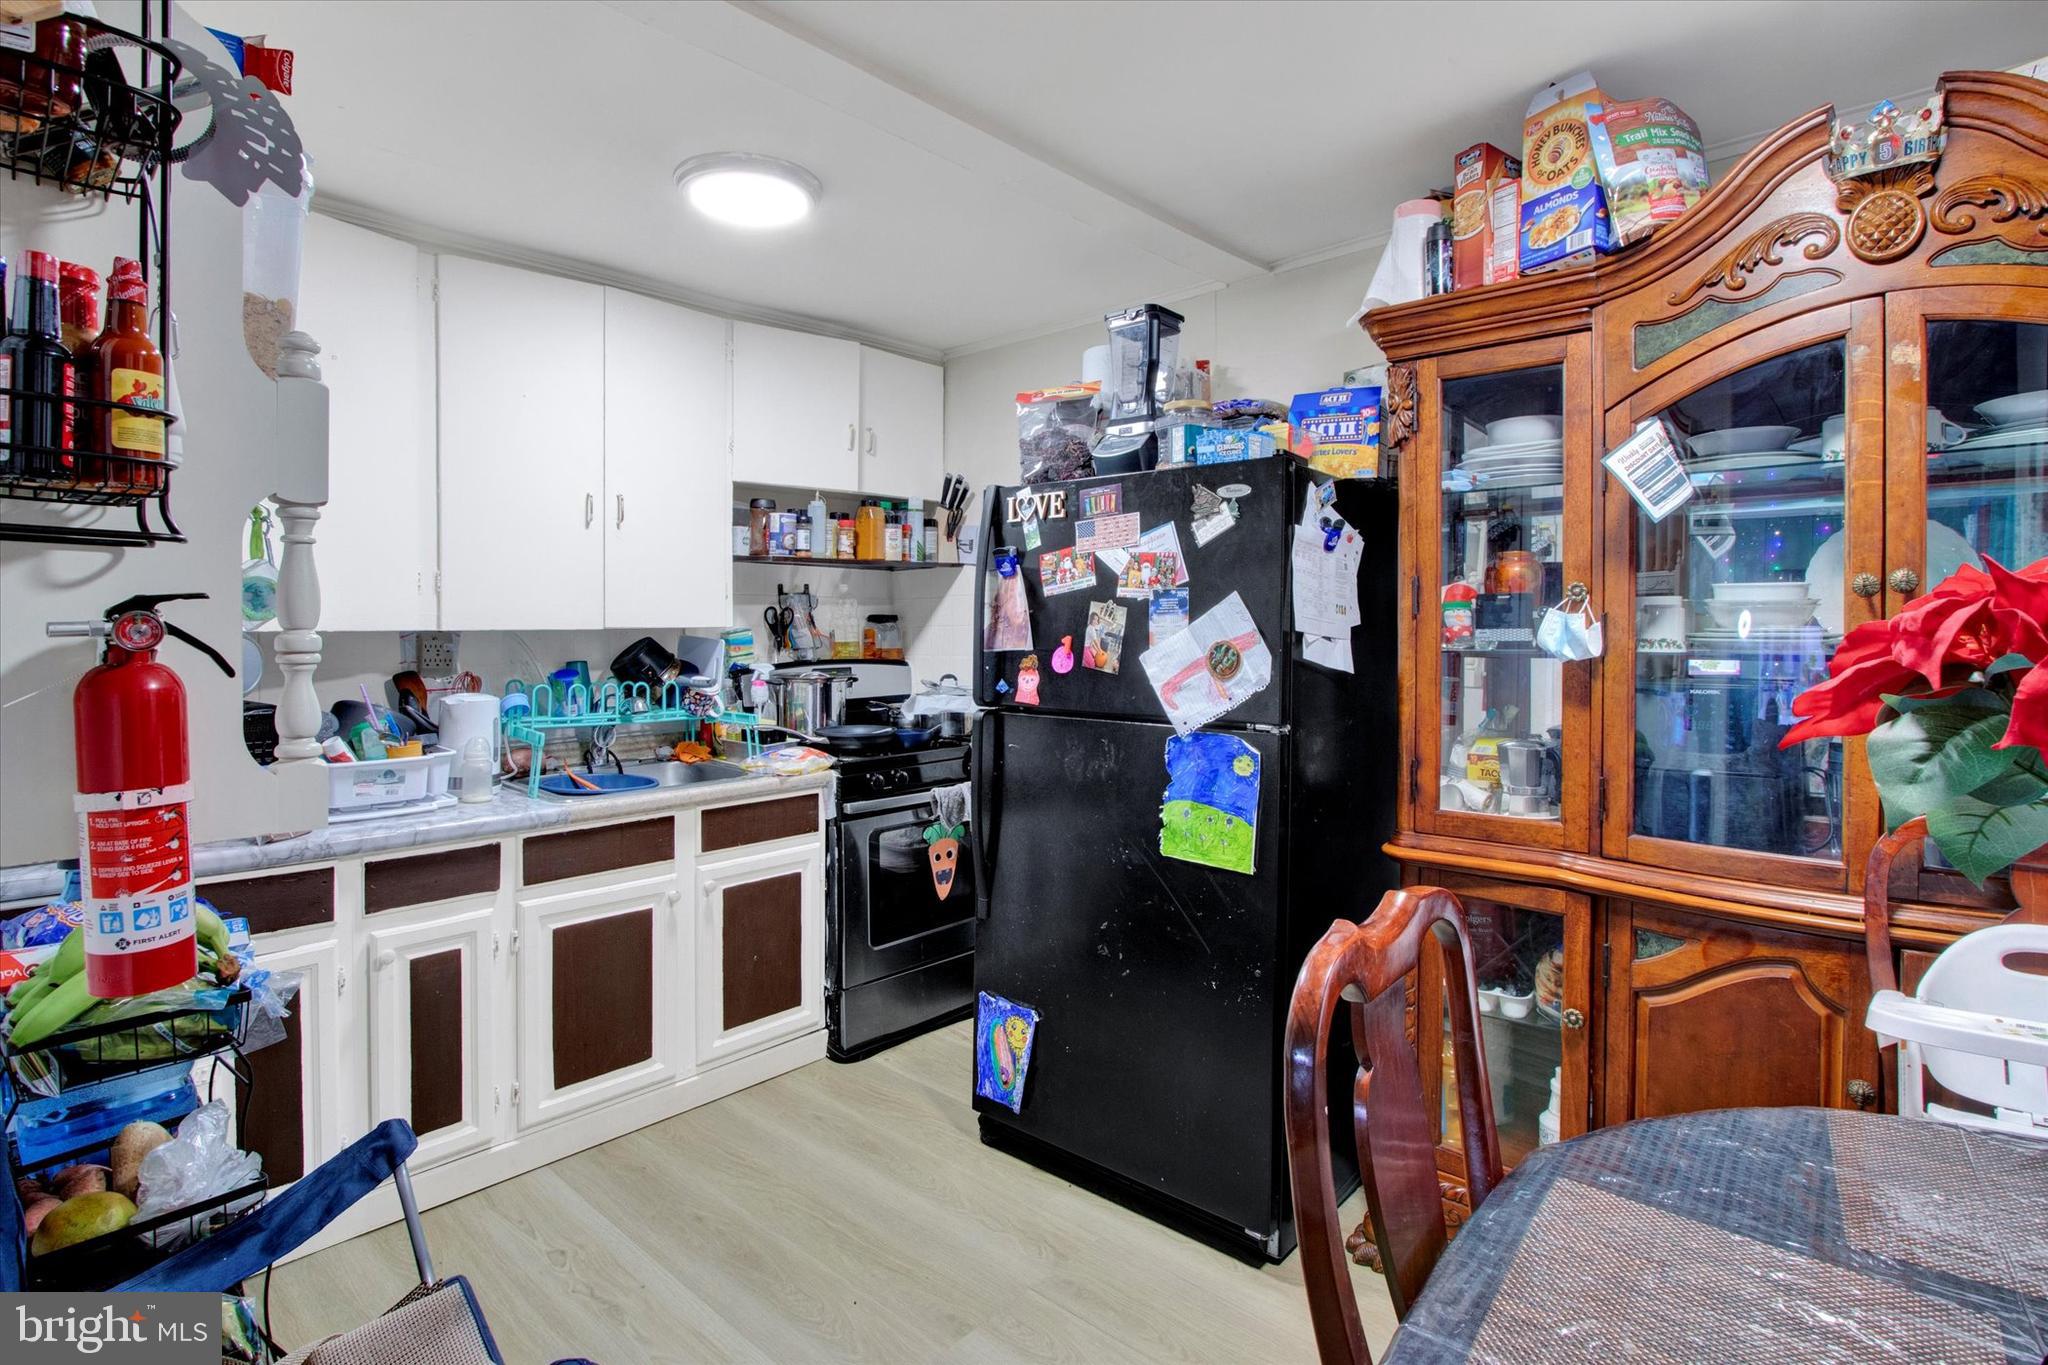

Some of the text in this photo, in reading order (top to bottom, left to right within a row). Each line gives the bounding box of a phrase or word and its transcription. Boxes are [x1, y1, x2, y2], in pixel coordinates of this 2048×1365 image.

[282, 52, 292, 88] Colgate
[1622, 129, 1648, 145] Trail
[1650, 127, 1669, 137] Mix
[1532, 122, 1584, 169] HONEY BUNCHES
[1879, 140, 1893, 160] 5
[1537, 156, 1578, 181] of OATS
[1533, 190, 1580, 215] ALMONDS
[1322, 395, 1338, 403] ACT
[1309, 421, 1357, 436] ACT II
[1332, 448, 1358, 456] Lovers
[1465, 914, 1492, 925] olgers
[133, 929, 181, 946] FIRST ALERT
